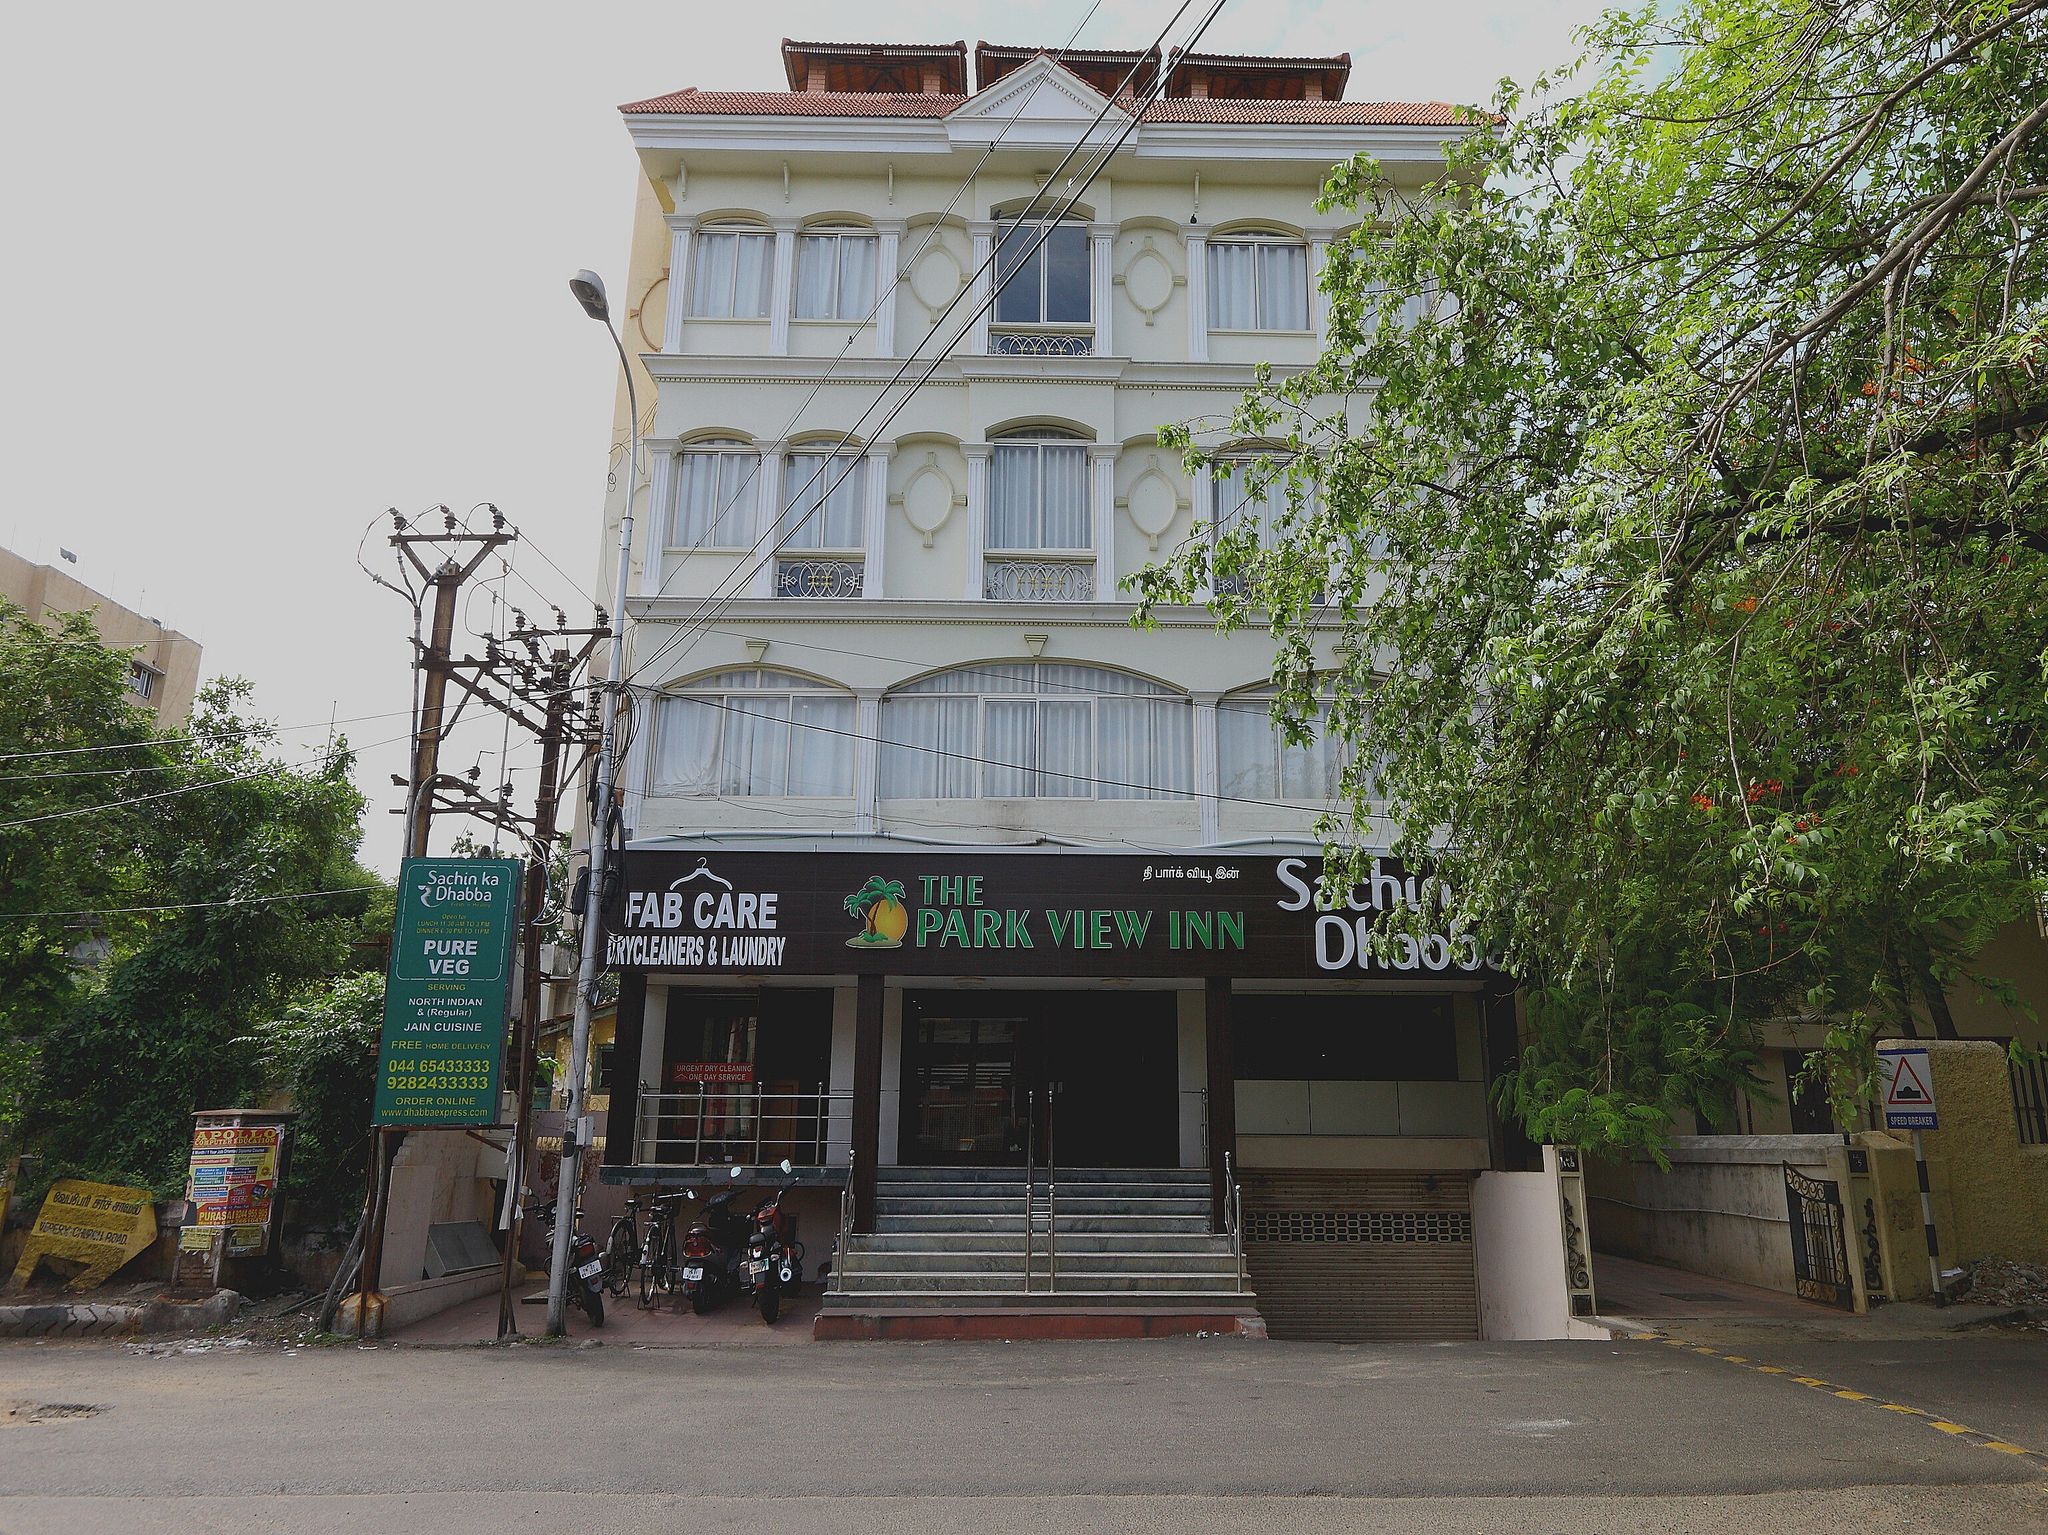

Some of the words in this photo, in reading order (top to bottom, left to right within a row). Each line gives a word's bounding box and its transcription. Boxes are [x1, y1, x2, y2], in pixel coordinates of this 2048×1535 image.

[427, 870, 477, 885] Sachin
[482, 871, 499, 886] ka
[1142, 866, 1153, 882] தி
[1155, 866, 1184, 879] பார்க்
[1186, 867, 1213, 884] வியூ
[1215, 866, 1240, 879] இன்
[436, 886, 492, 901] Dhabba
[918, 875, 984, 906] THE
[627, 892, 683, 929] FAB
[693, 892, 778, 930] CARE
[916, 909, 1035, 949] PARK
[1046, 910, 1153, 950] VIEW
[1169, 910, 1245, 950] INN
[423, 940, 478, 956] PURE
[606, 935, 705, 966] DRYCLEANERS
[707, 935, 718, 967] &
[721, 936, 787, 967] LAUNDRY
[429, 959, 470, 975] VEG
[408, 998, 444, 1006] NORTH
[447, 998, 483, 1006] INDIAN
[417, 1008, 424, 1016] &
[427, 1008, 472, 1018] (Regular)
[404, 1022, 431, 1032] JAIN
[434, 1022, 482, 1032] CUISINE
[391, 1040, 422, 1049] FREE
[389, 1060, 415, 1073] 044
[419, 1060, 490, 1073] 65433333
[387, 1077, 489, 1090] 9282433333
[395, 1097, 433, 1106] ORDER
[436, 1097, 476, 1106] ONLINE
[381, 1107, 488, 1119] www.dhabbaexpress.com
[1890, 1116, 1908, 1125] SPEED
[1908, 1116, 1934, 1125] BREAKER
[198, 1129, 277, 1139] APOLLO
[195, 1138, 232, 1146] COMPUTER
[233, 1137, 275, 1145] EDUCATION
